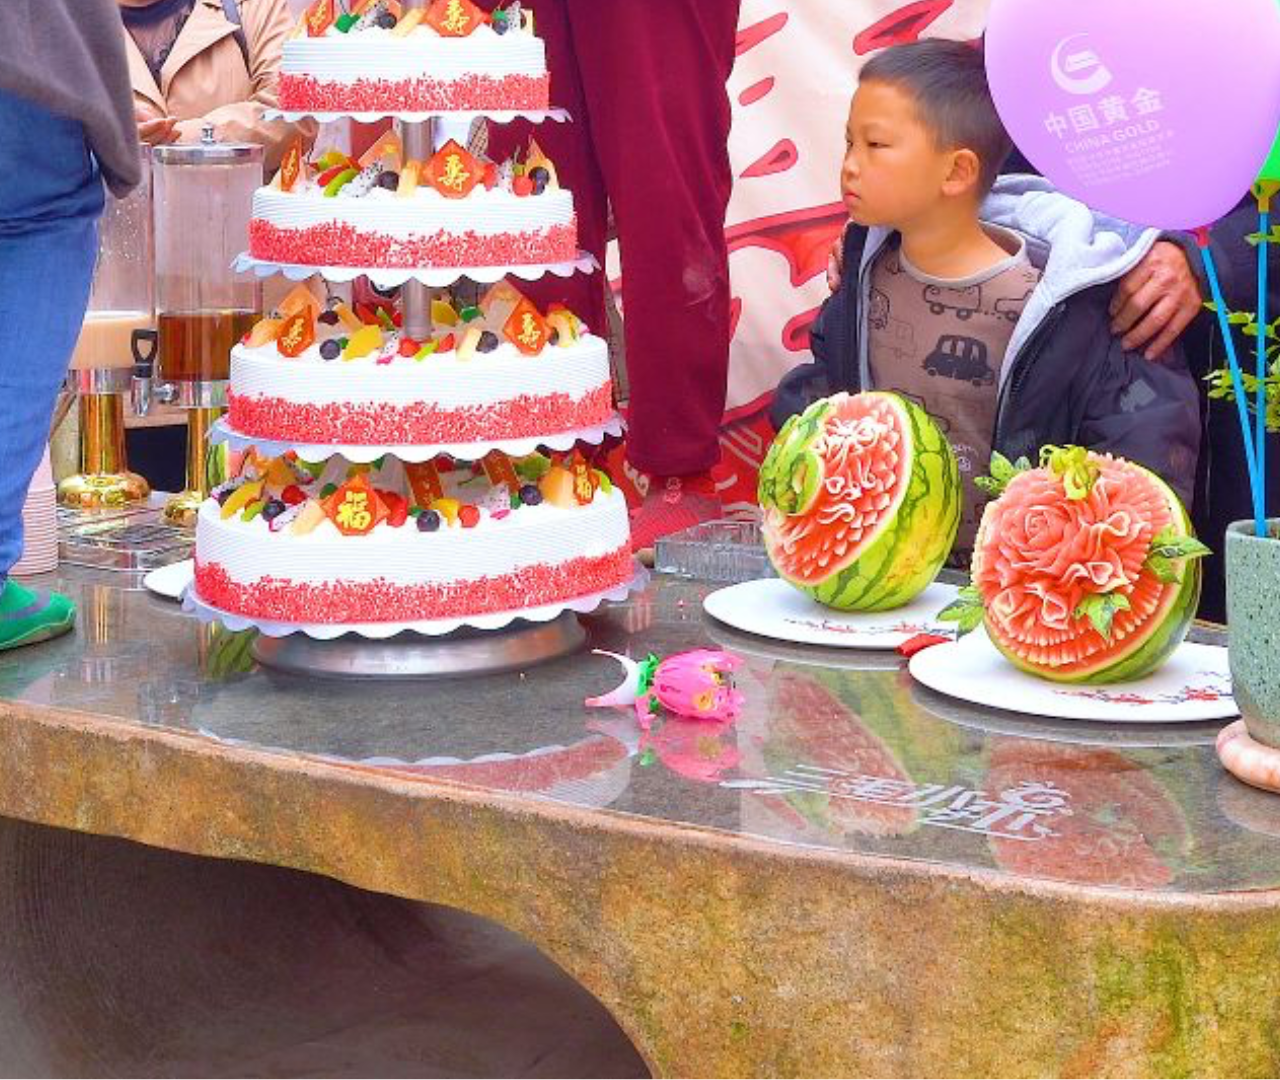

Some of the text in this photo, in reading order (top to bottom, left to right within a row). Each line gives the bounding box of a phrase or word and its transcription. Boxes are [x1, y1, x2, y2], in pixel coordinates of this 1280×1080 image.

[1044, 87, 1164, 140] 中国黄金
[1065, 119, 1160, 154] CHINA GOLD
[335, 490, 372, 530] 福
